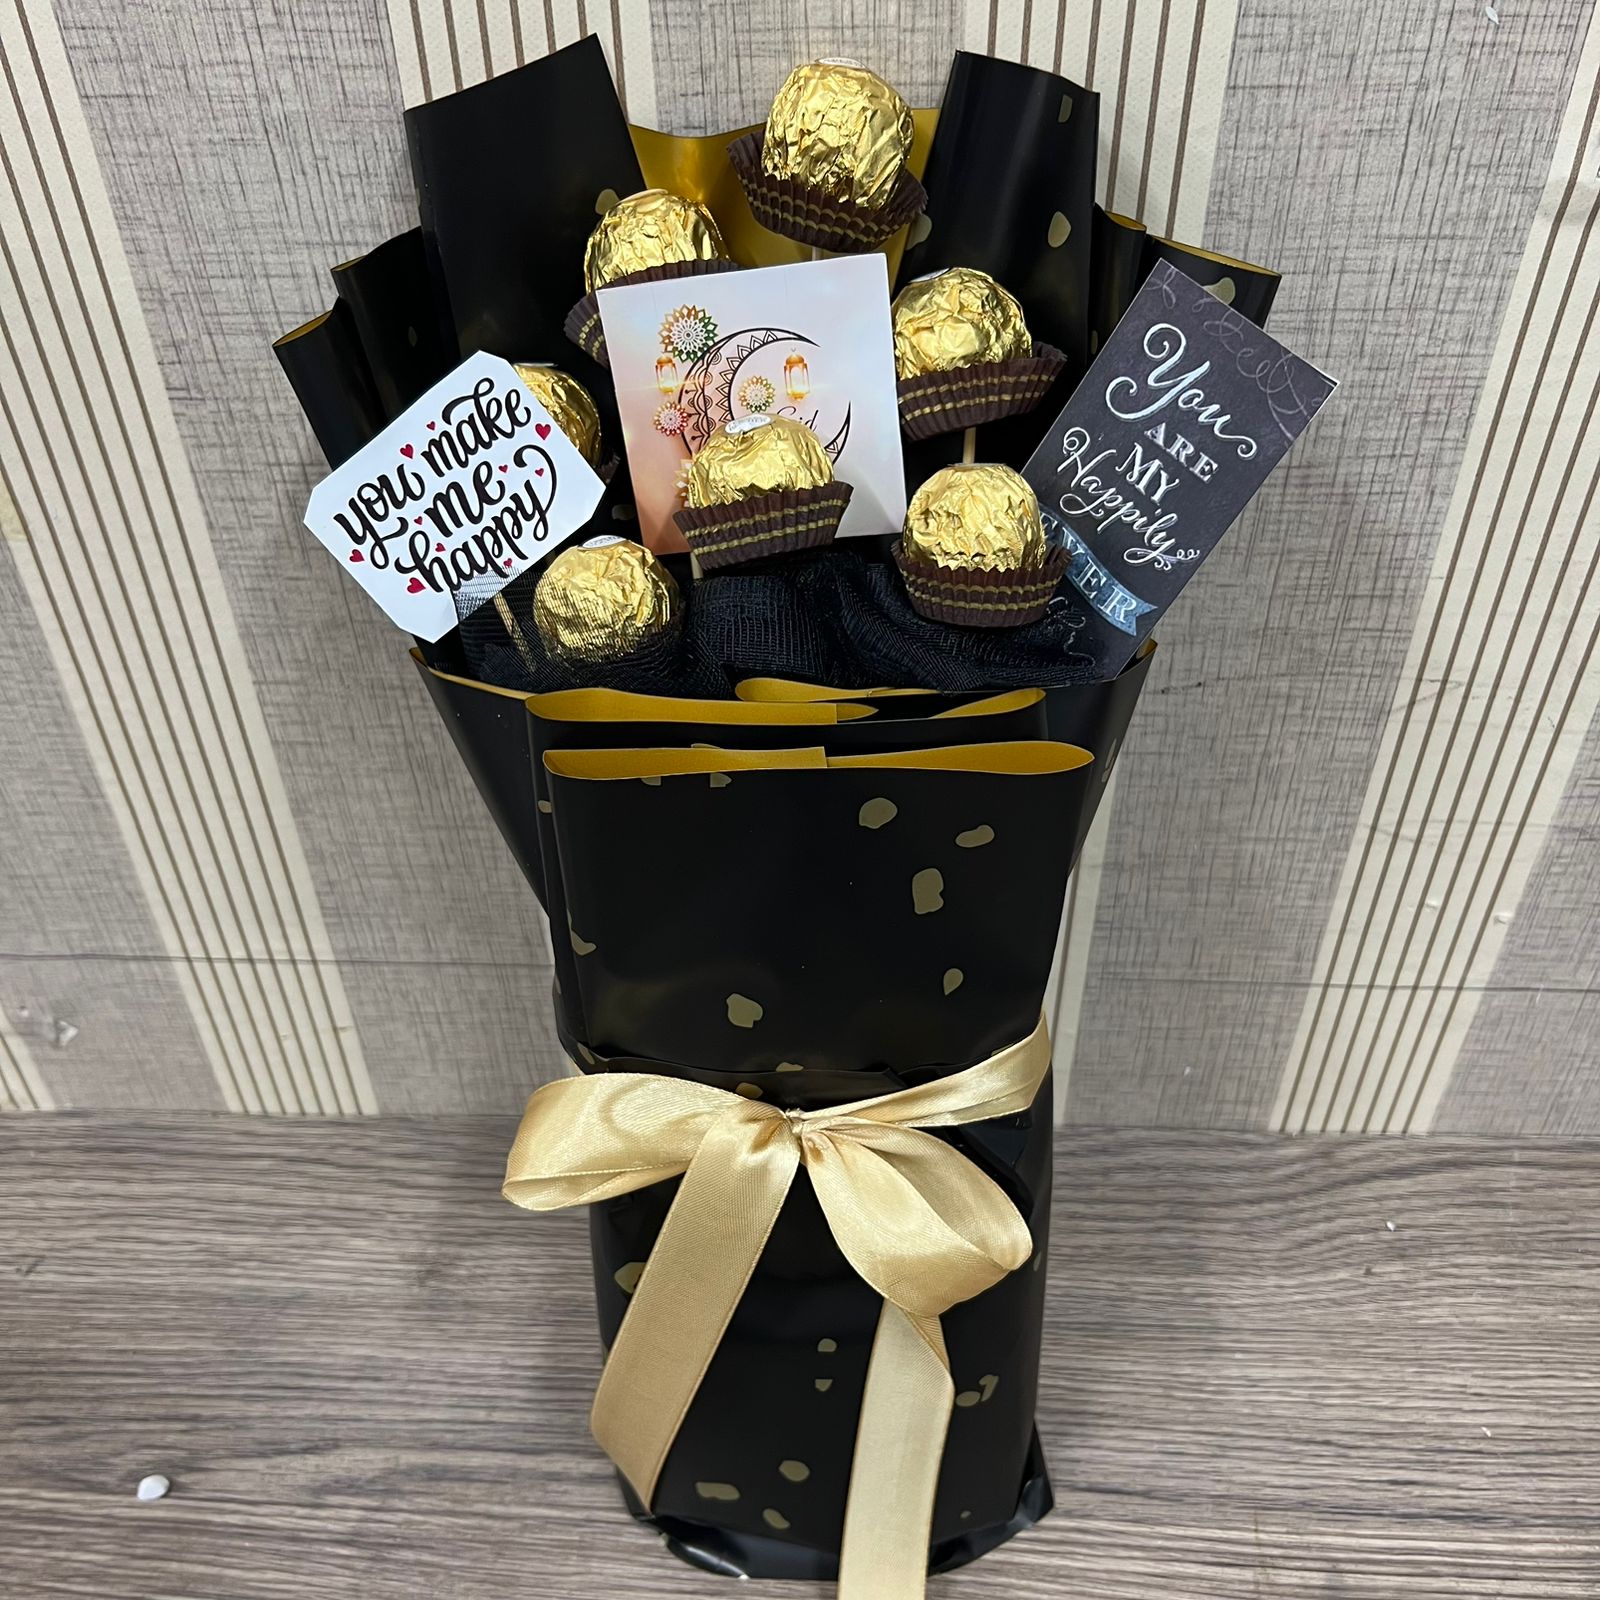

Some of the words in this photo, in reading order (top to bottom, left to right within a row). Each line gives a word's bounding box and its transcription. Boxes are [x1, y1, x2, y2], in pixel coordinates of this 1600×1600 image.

[1105, 322, 1258, 460] You
[1143, 422, 1220, 484] ARE
[332, 463, 426, 570] you
[420, 377, 532, 478] make
[394, 444, 557, 593] happy
[423, 460, 506, 538] me
[1056, 426, 1199, 570] Happily
[1115, 442, 1182, 505] MY
